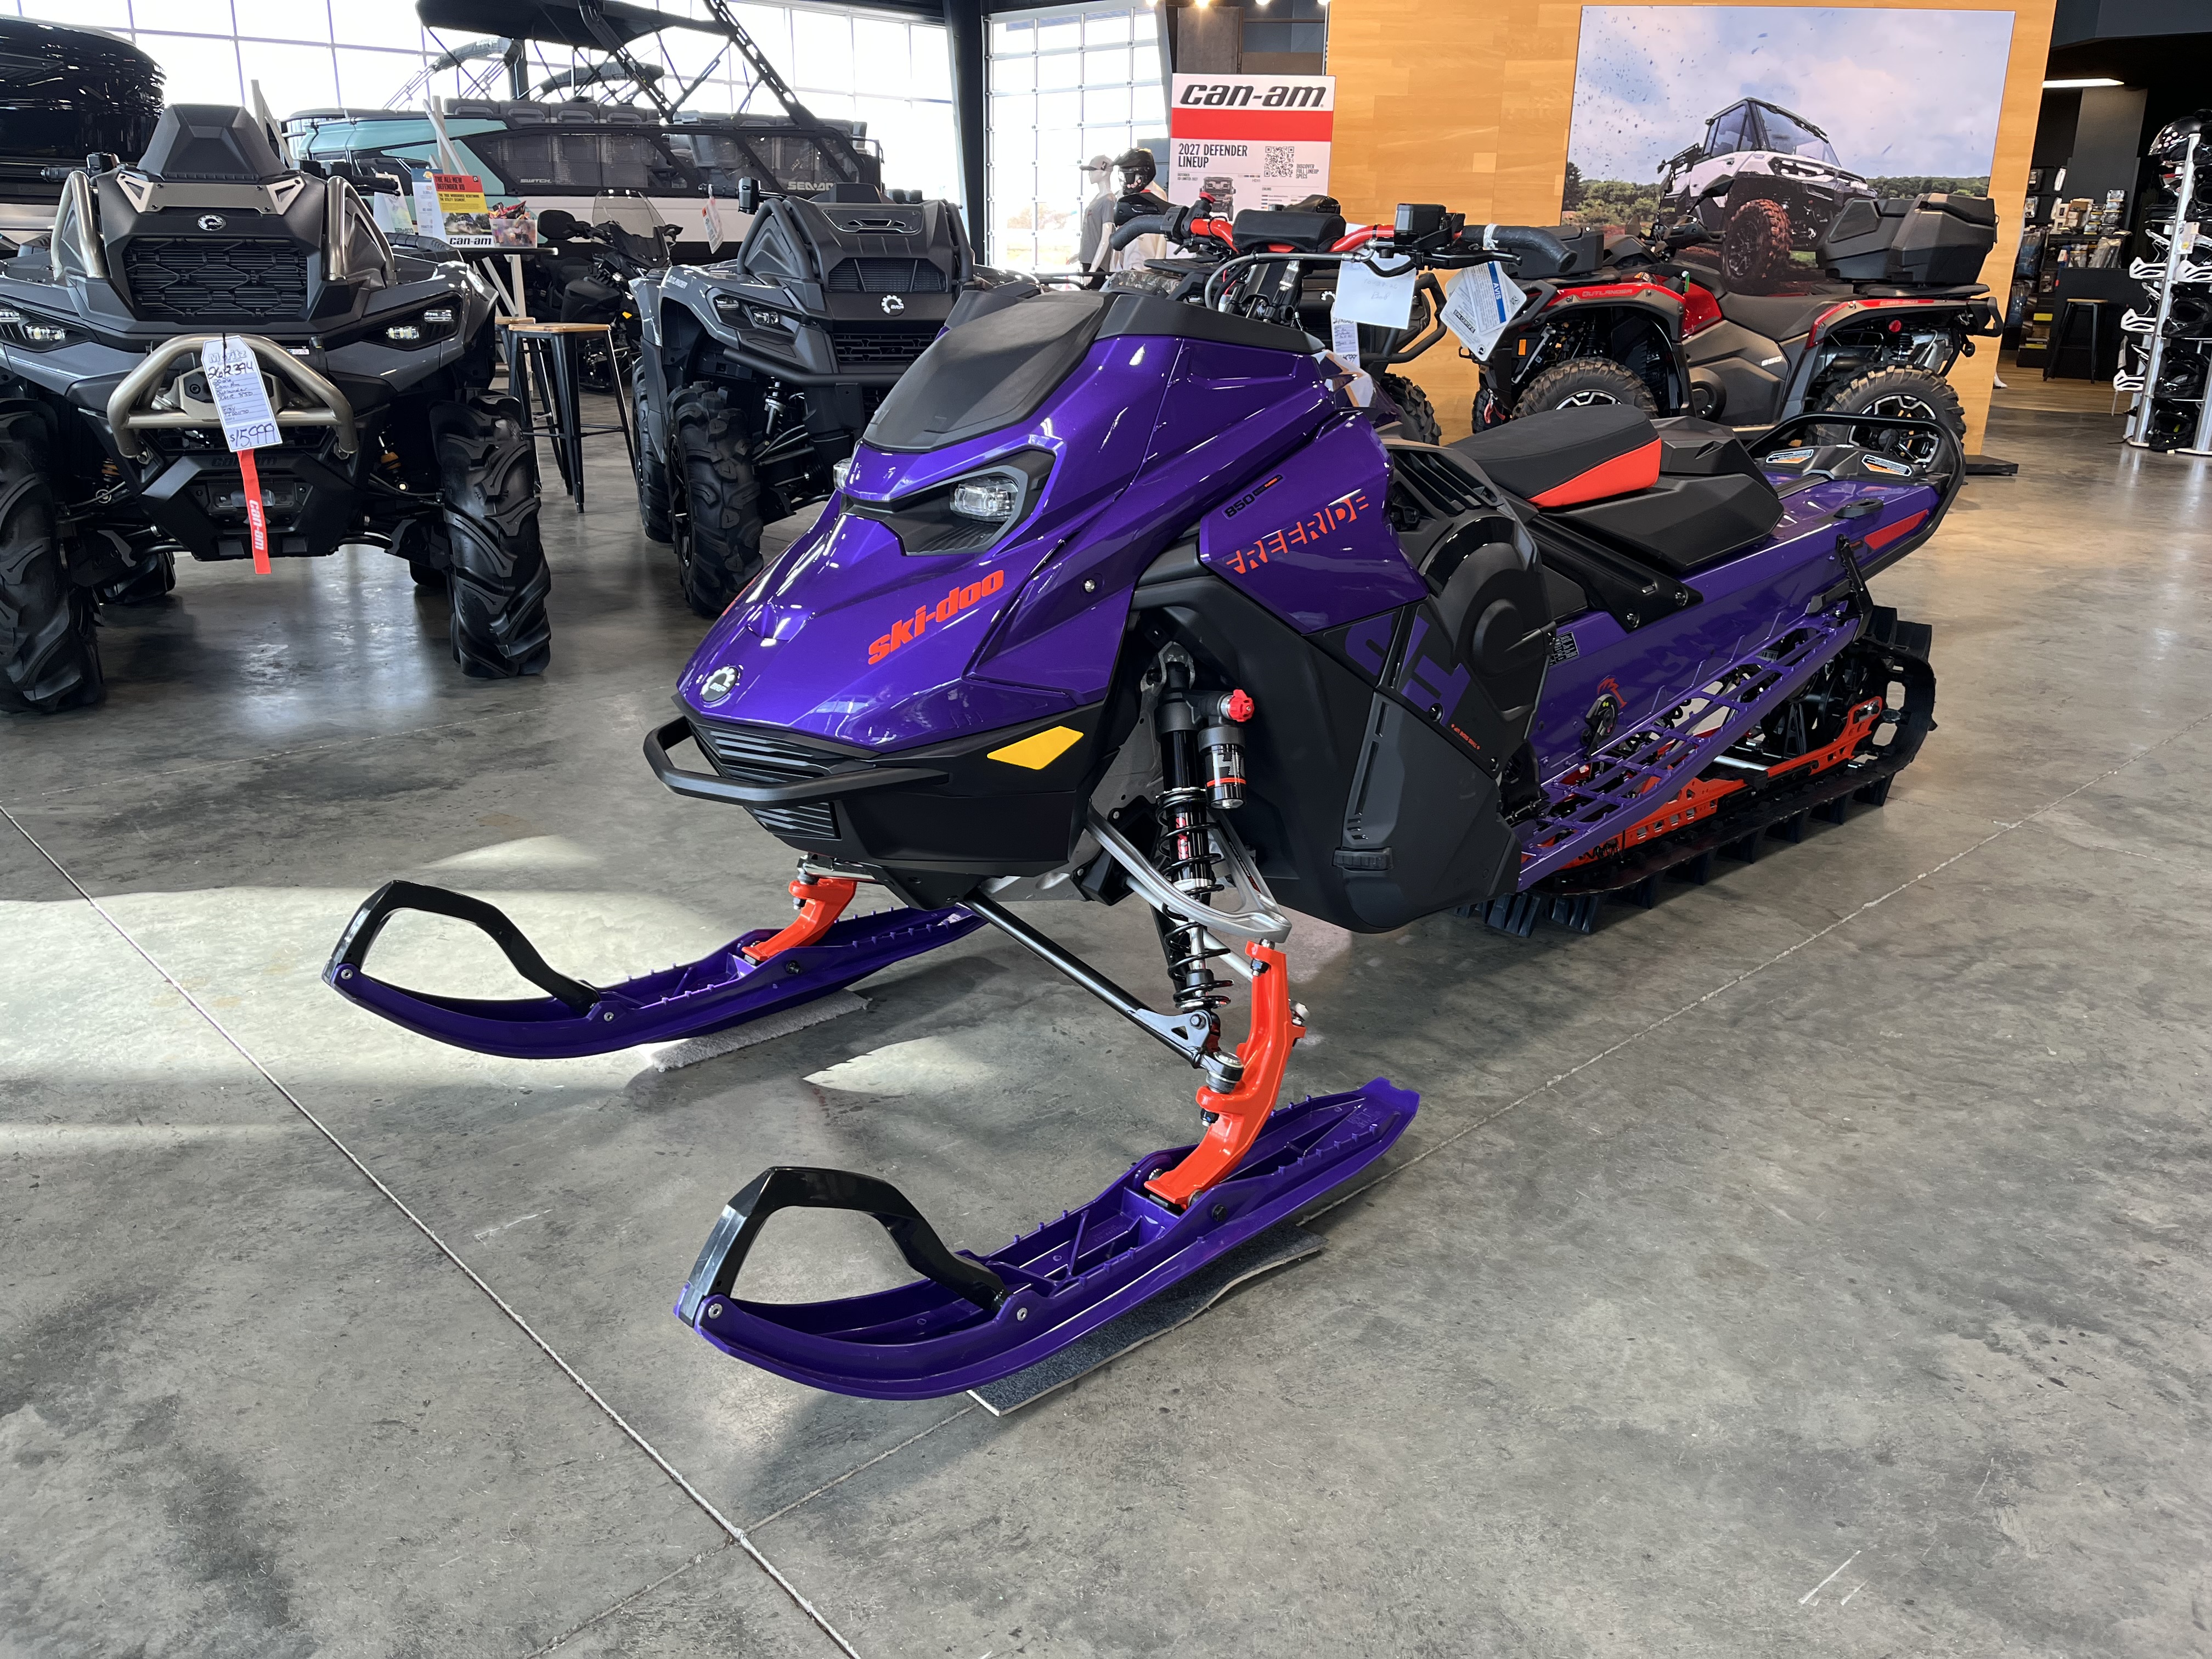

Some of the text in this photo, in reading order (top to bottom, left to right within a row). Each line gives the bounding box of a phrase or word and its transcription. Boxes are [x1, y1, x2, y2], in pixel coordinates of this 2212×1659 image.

[1180, 84, 1327, 108] can-am
[1178, 143, 1248, 157] 2027 DEFENDER
[1178, 156, 1209, 168] LINEUP
[1493, 282, 1502, 300] AVIS
[229, 422, 276, 447] $15,999
[1224, 494, 1255, 517] 850
[249, 499, 264, 551] can-am
[1226, 495, 1369, 574] FREERIDE
[868, 569, 1005, 665] ski-doo
[709, 682, 727, 692] BRP
